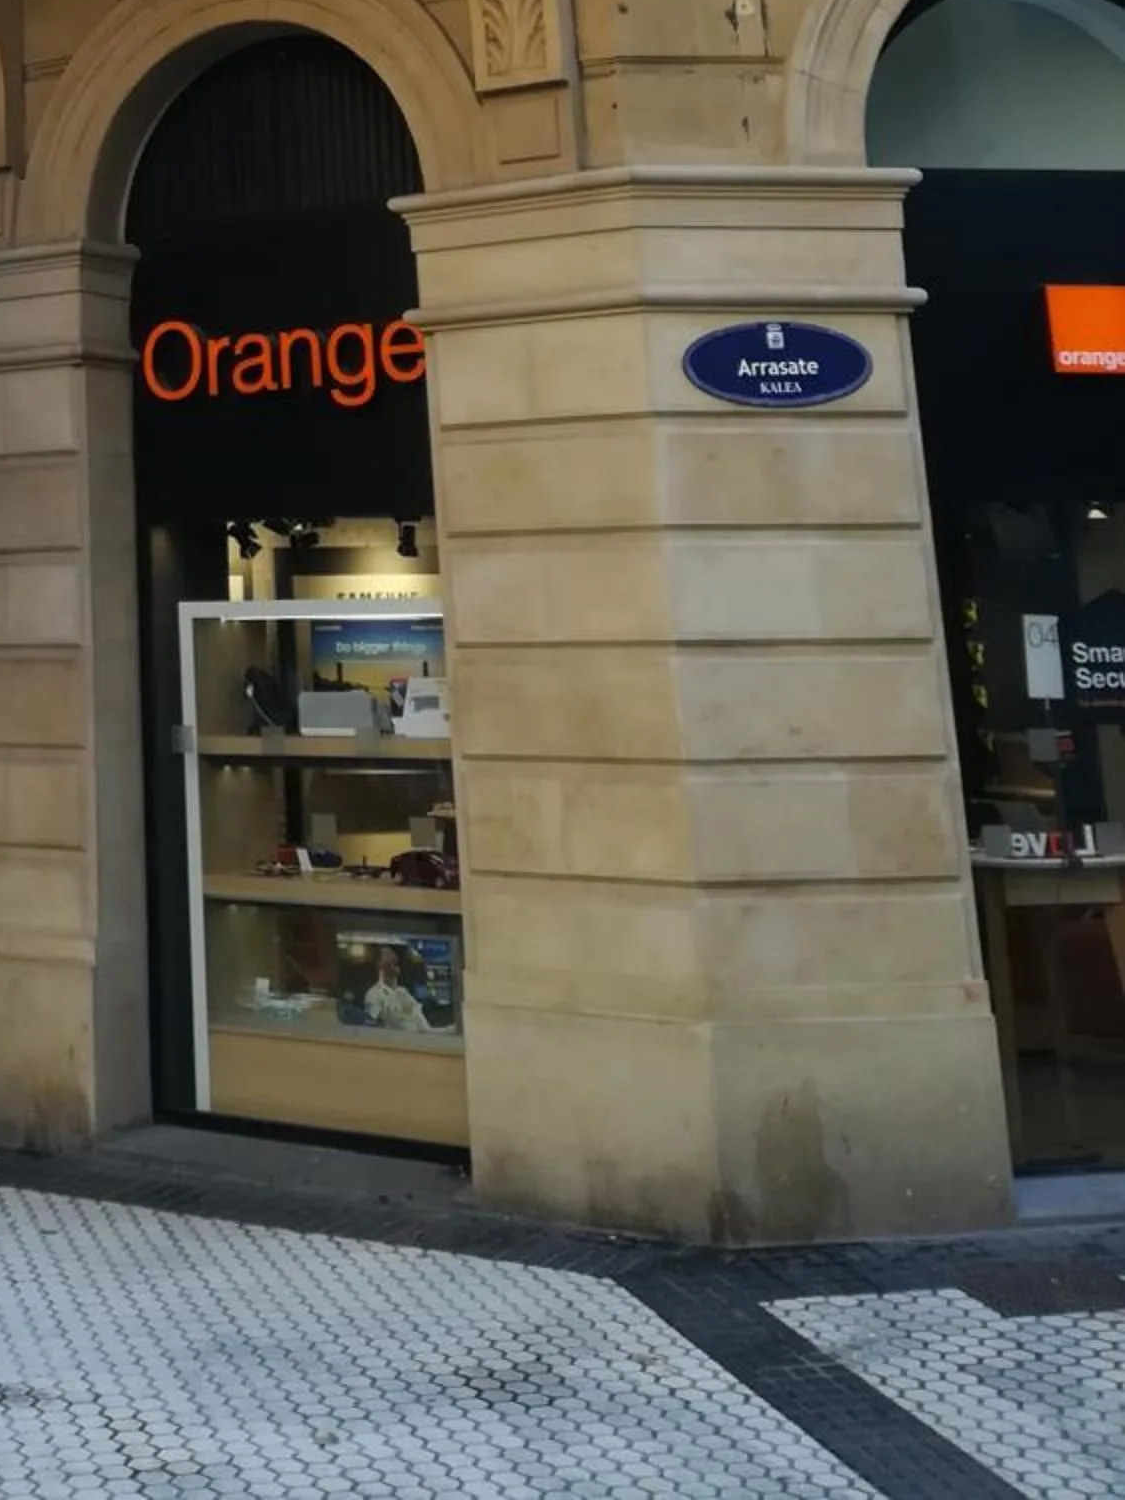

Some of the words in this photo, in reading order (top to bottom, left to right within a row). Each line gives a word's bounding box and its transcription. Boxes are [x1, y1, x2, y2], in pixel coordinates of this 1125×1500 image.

[142, 320, 425, 408] Orange
[737, 358, 820, 377] Arrasate
[760, 381, 803, 394] KALEA
[1071, 641, 1125, 663] Sma
